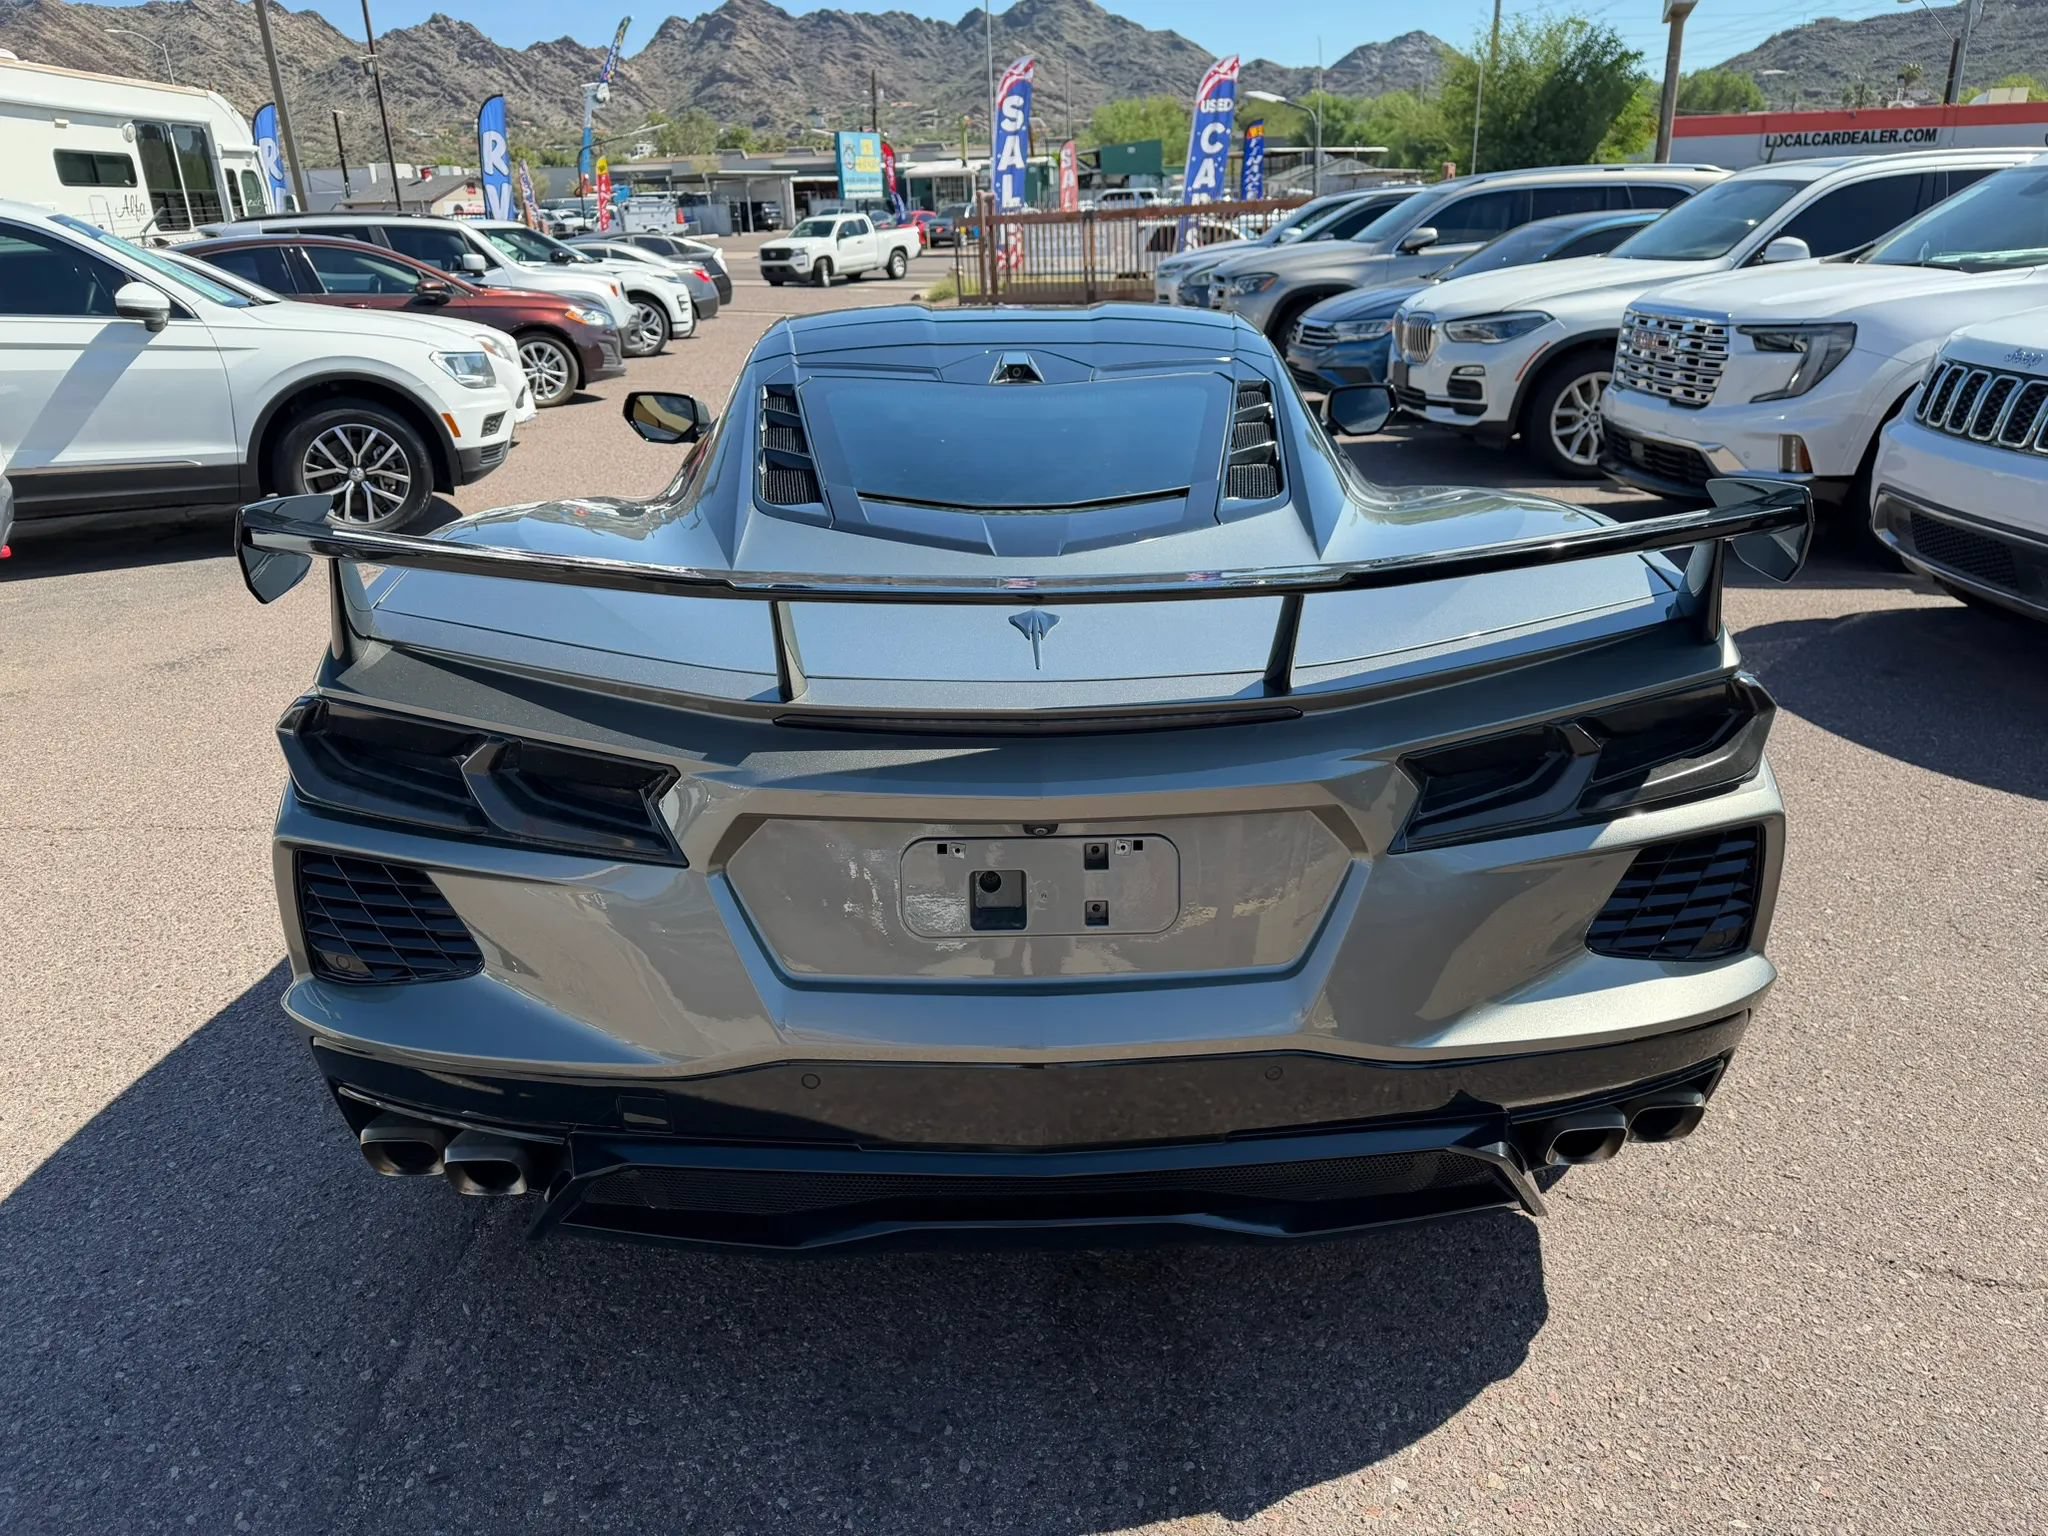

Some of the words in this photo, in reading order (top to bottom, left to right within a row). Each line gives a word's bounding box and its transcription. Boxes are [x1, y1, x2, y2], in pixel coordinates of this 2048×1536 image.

[1200, 98, 1234, 113] USED
[1765, 128, 1938, 148] LOCALCARDEALER.COM
[997, 95, 1025, 215] SAL
[115, 194, 147, 222] Alfa
